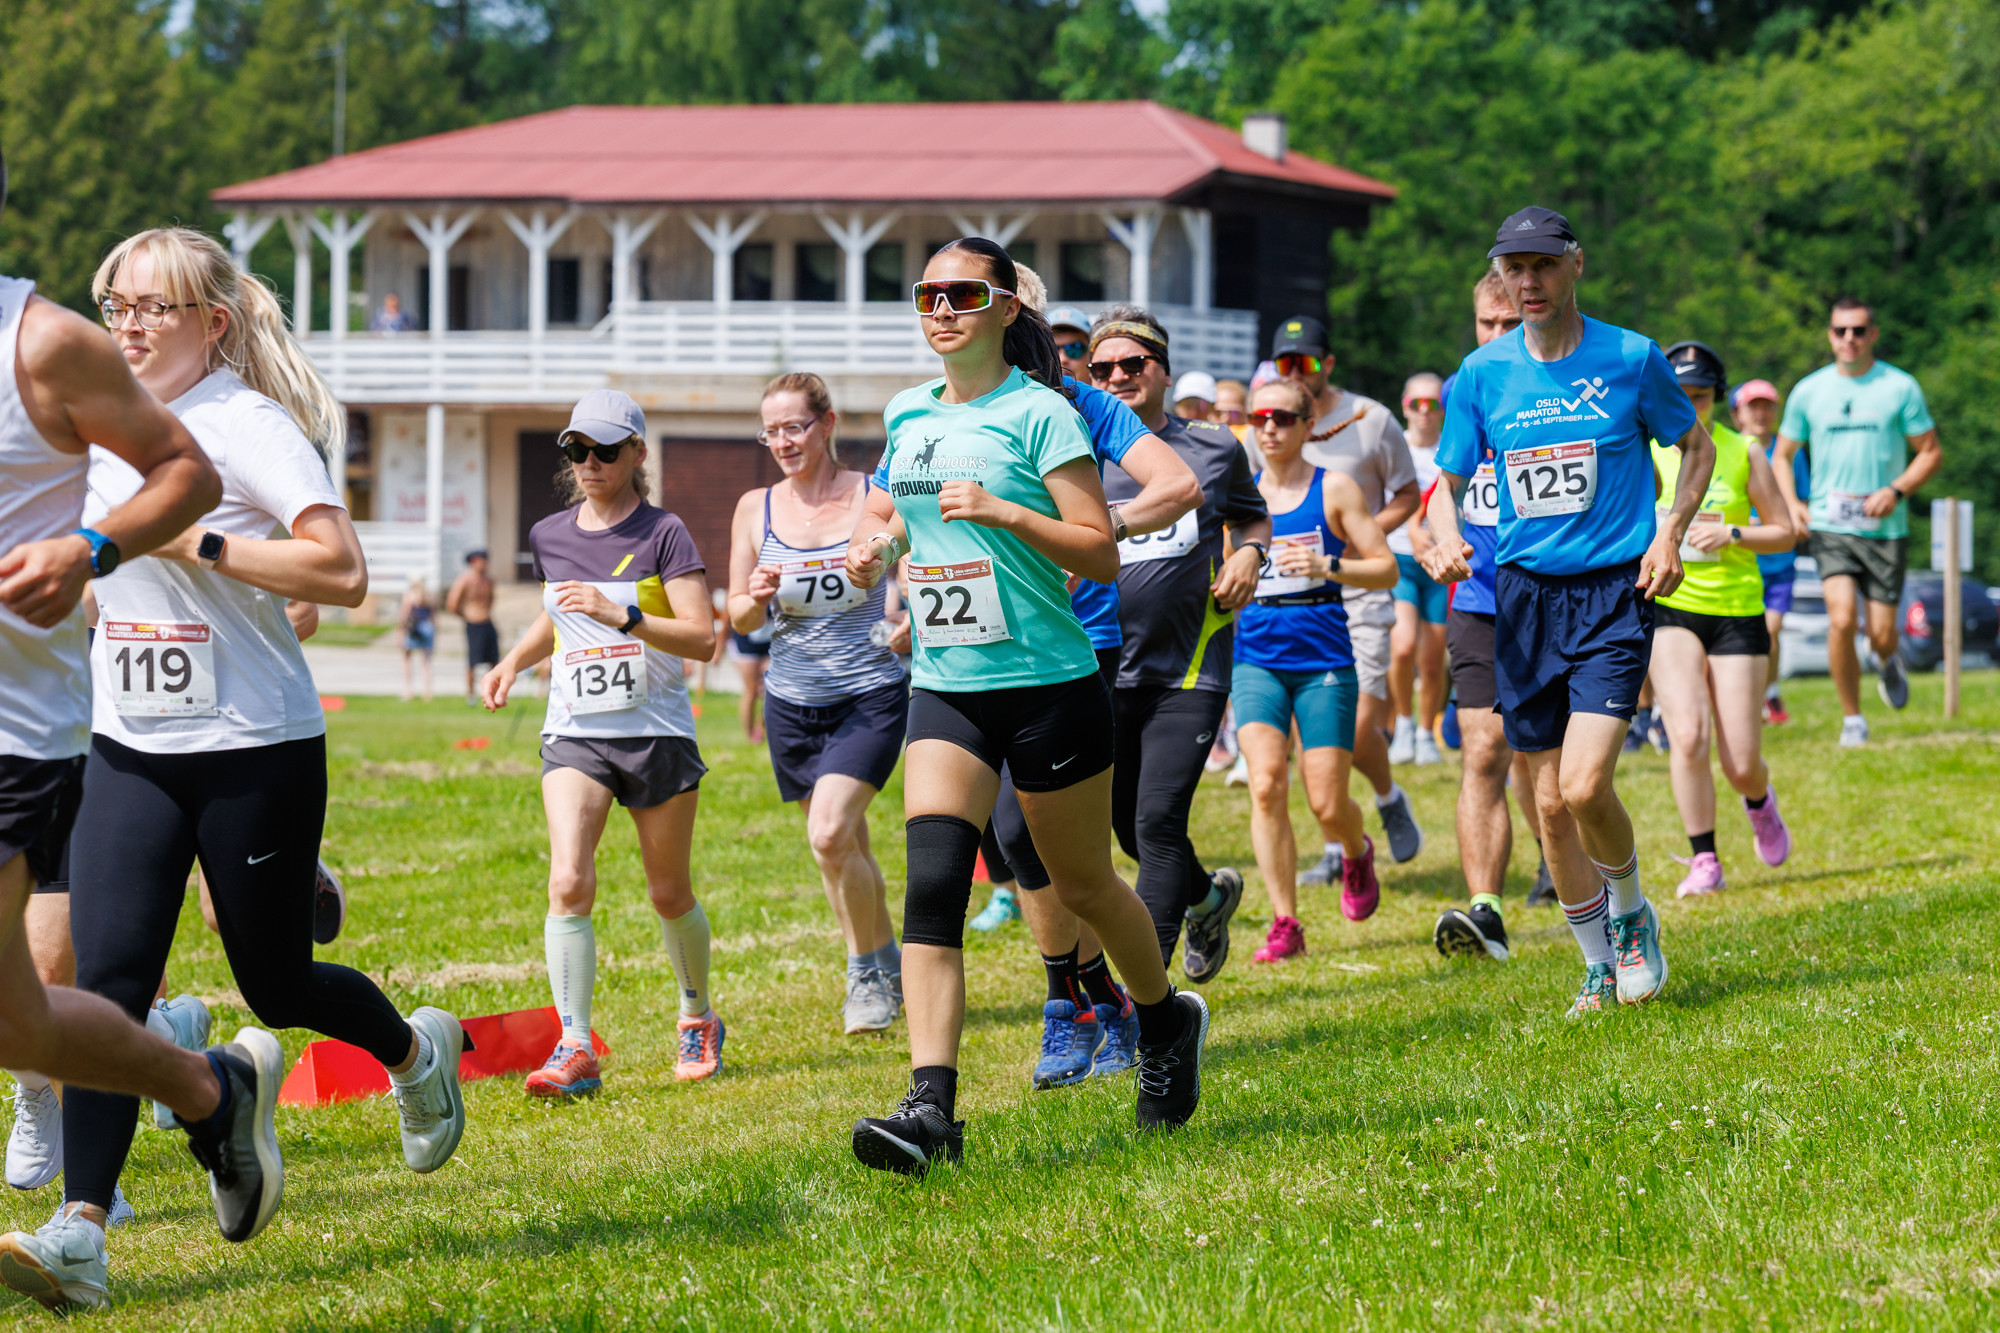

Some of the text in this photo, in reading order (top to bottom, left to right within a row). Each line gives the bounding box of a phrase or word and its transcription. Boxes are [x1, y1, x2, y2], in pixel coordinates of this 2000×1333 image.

[1516, 407, 1561, 421] MARATON
[1536, 397, 1560, 409] OSLO
[1542, 414, 1583, 425] SEPTEMBER
[1516, 461, 1588, 502] 125
[796, 573, 845, 604] 79
[919, 585, 978, 627] 22
[115, 647, 192, 693] 119
[571, 661, 636, 698] 134
